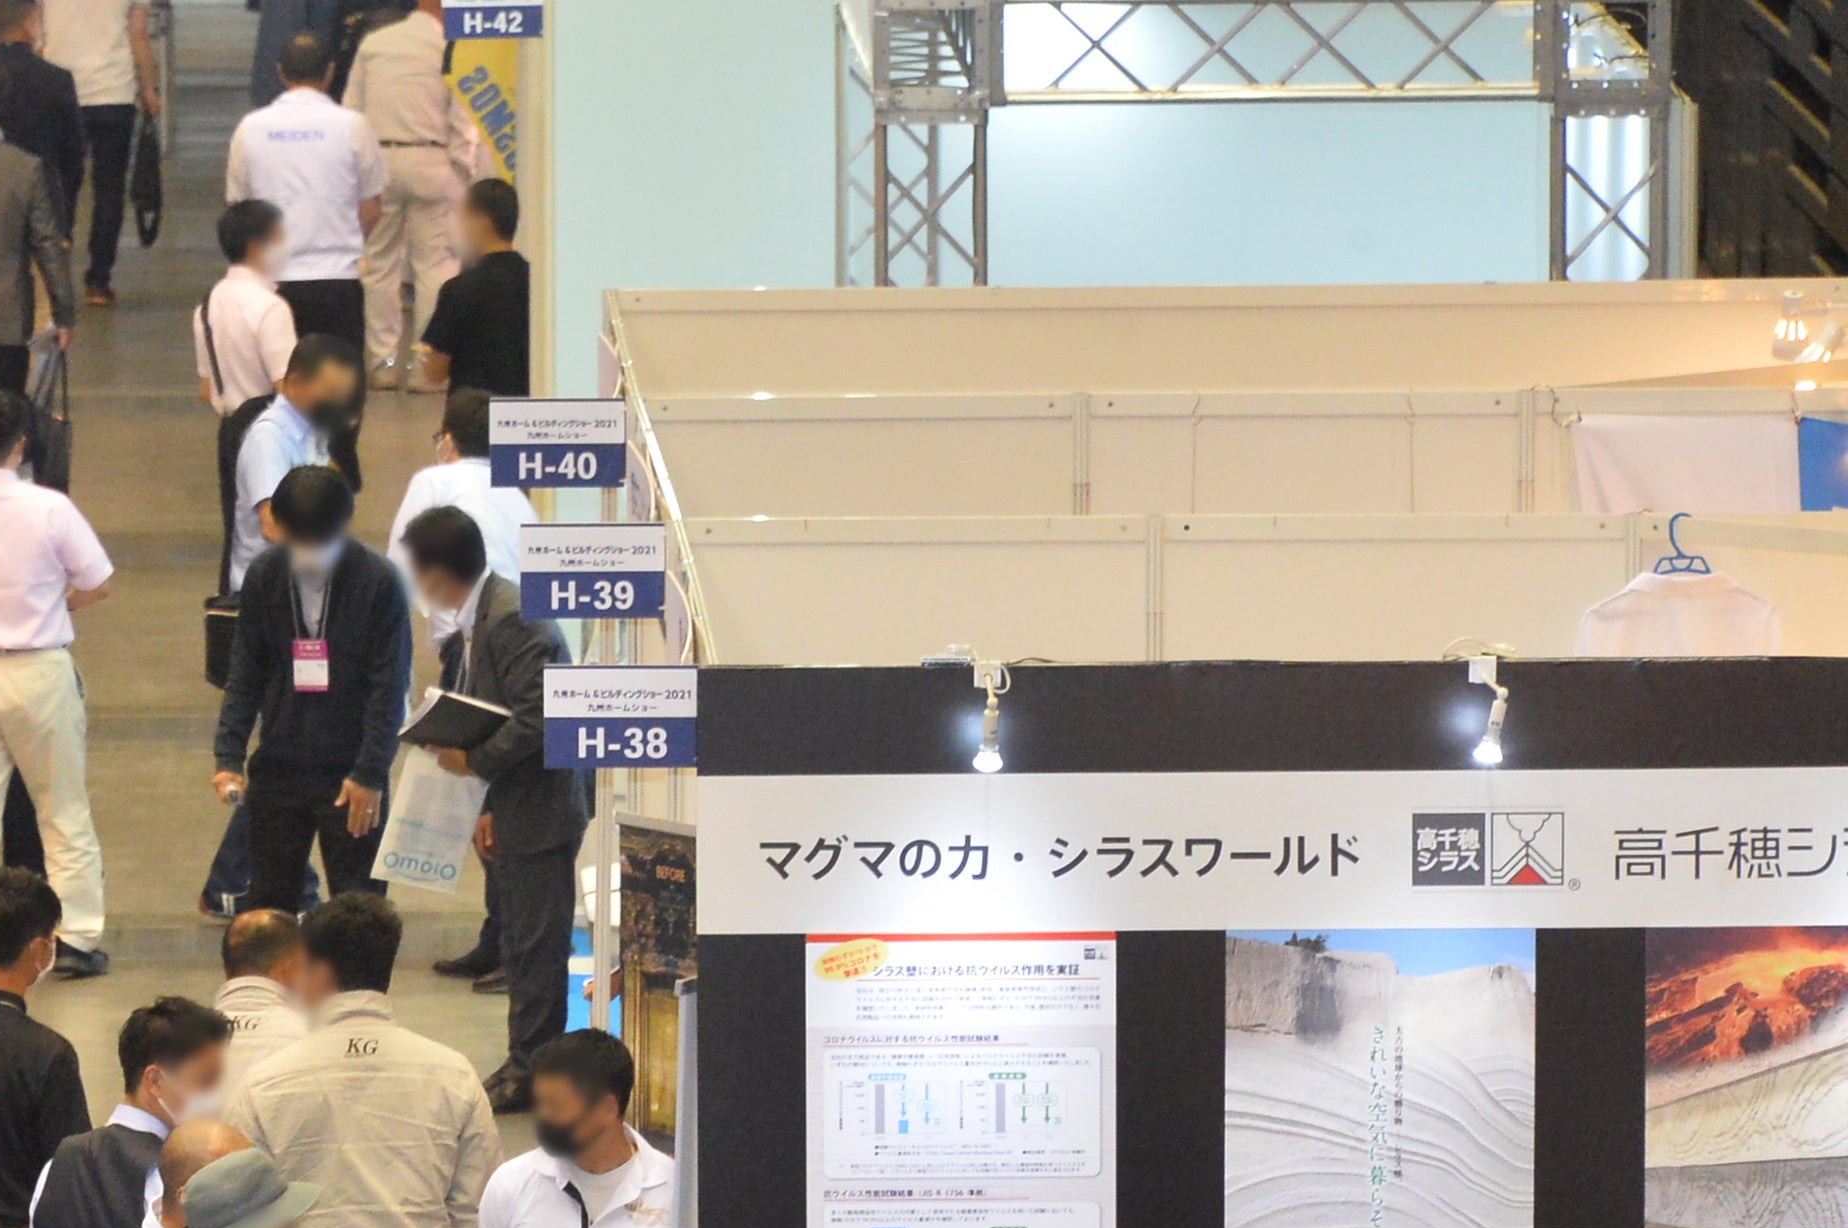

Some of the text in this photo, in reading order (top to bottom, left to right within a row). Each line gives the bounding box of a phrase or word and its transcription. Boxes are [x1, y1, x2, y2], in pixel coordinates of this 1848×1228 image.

[462, 12, 524, 34] H-42
[267, 129, 325, 142] MEIDEN
[518, 452, 597, 481] H-40
[550, 580, 635, 611] H-39
[578, 727, 668, 759] H-38
[1415, 826, 1482, 850] 高千穂
[1416, 851, 1482, 872] シラス
[345, 1038, 380, 1057] KG
